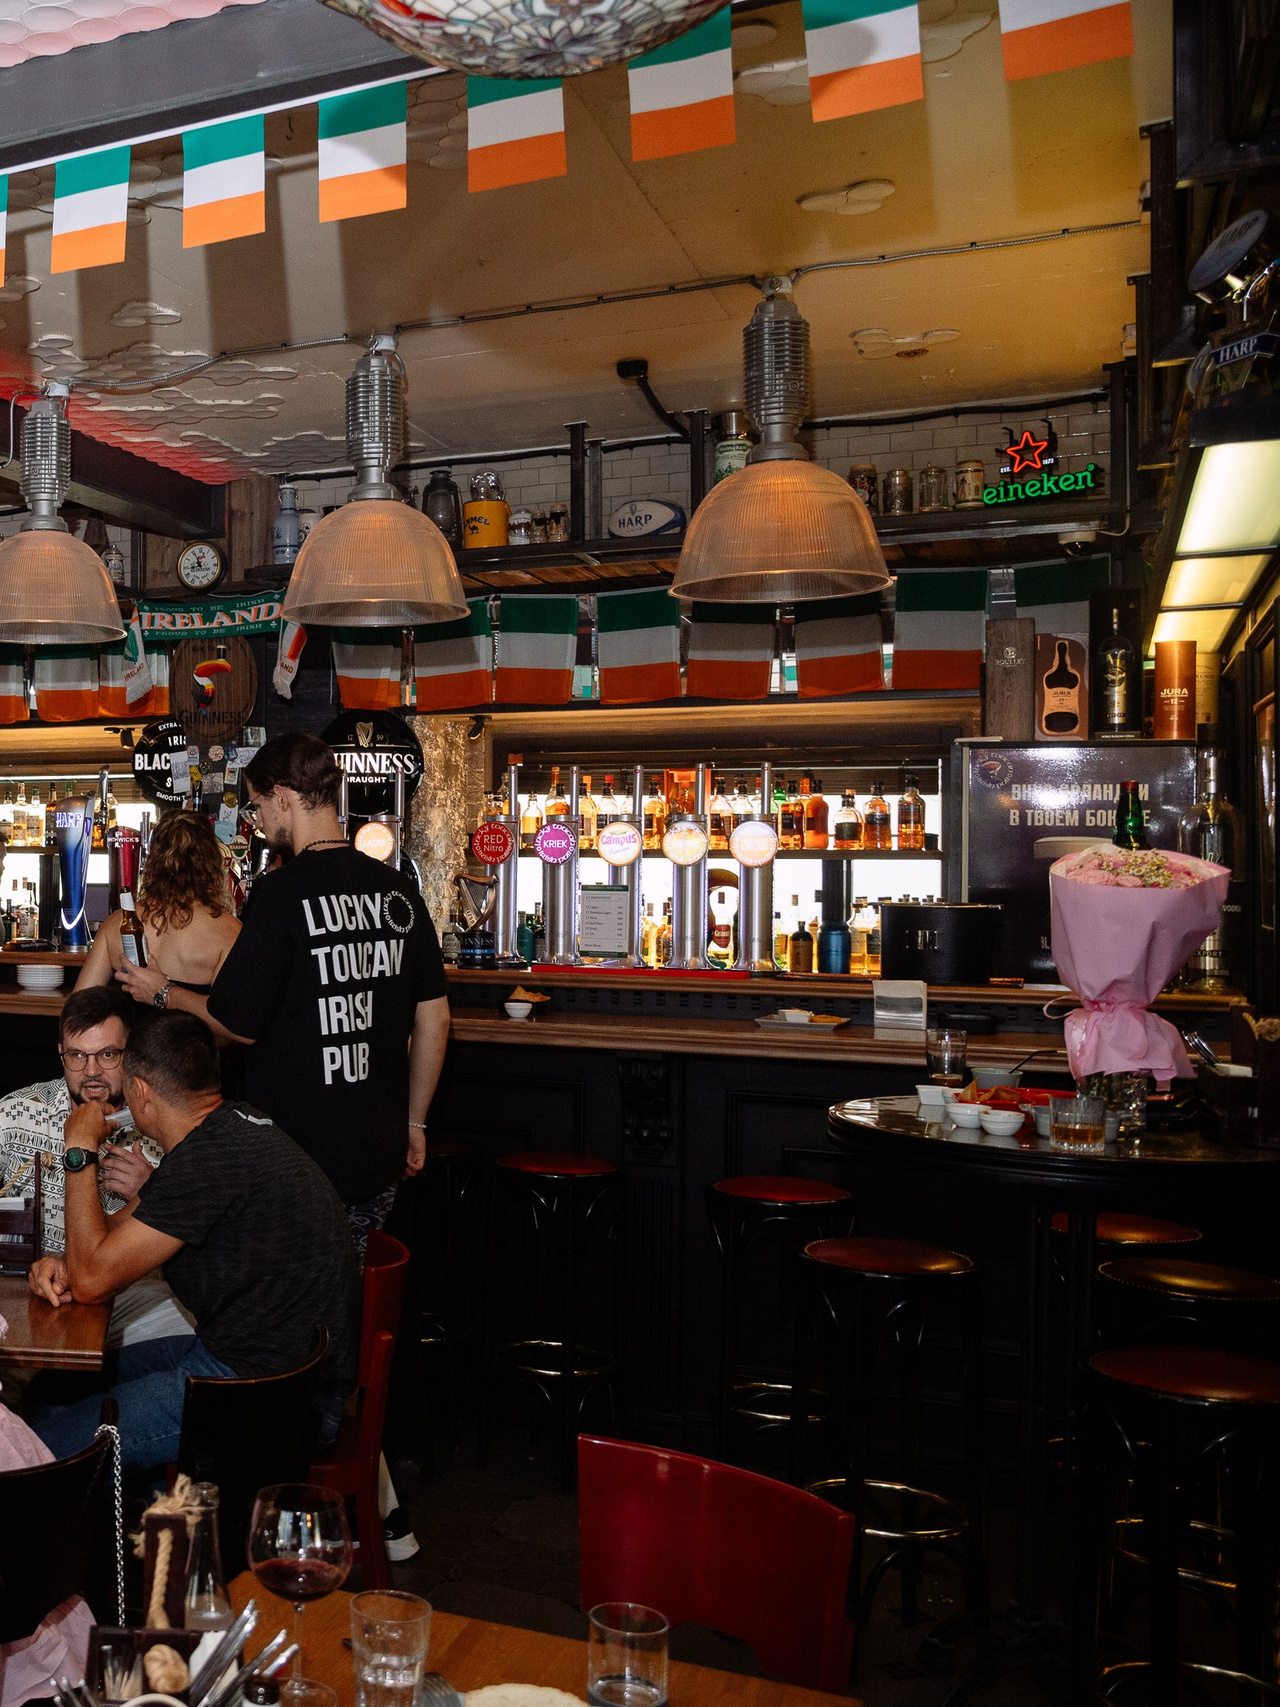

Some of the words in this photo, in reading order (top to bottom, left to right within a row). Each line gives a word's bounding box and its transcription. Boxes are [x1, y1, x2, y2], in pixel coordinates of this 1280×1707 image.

[1219, 338, 1258, 363] HARP
[982, 469, 1095, 504] eineken
[618, 514, 653, 529] HARP
[236, 597, 265, 608] IRISH
[139, 602, 284, 631] IRELAND
[236, 623, 262, 631] IRISH
[123, 662, 145, 682] IRELAND
[1160, 688, 1189, 696] JURA
[158, 722, 177, 732] EXTRA
[134, 752, 170, 771] BLAC
[333, 752, 415, 774] UINNESS
[156, 791, 181, 802] SMOOTH
[1060, 783, 1150, 804] ИРЛАНДИ
[55, 812, 83, 828] HARP
[1009, 809, 1020, 826] В
[1025, 809, 1080, 827] ТВОЕМ
[483, 834, 504, 844] RED
[543, 839, 568, 848] KRIEK
[600, 833, 638, 846] Campus
[483, 844, 504, 852] Nitro
[302, 892, 382, 937] LUCKY
[1222, 904, 1242, 913] VODKA
[310, 939, 405, 985] TOUCAN
[318, 991, 373, 1036] IRISH
[322, 1042, 370, 1085] PUB
